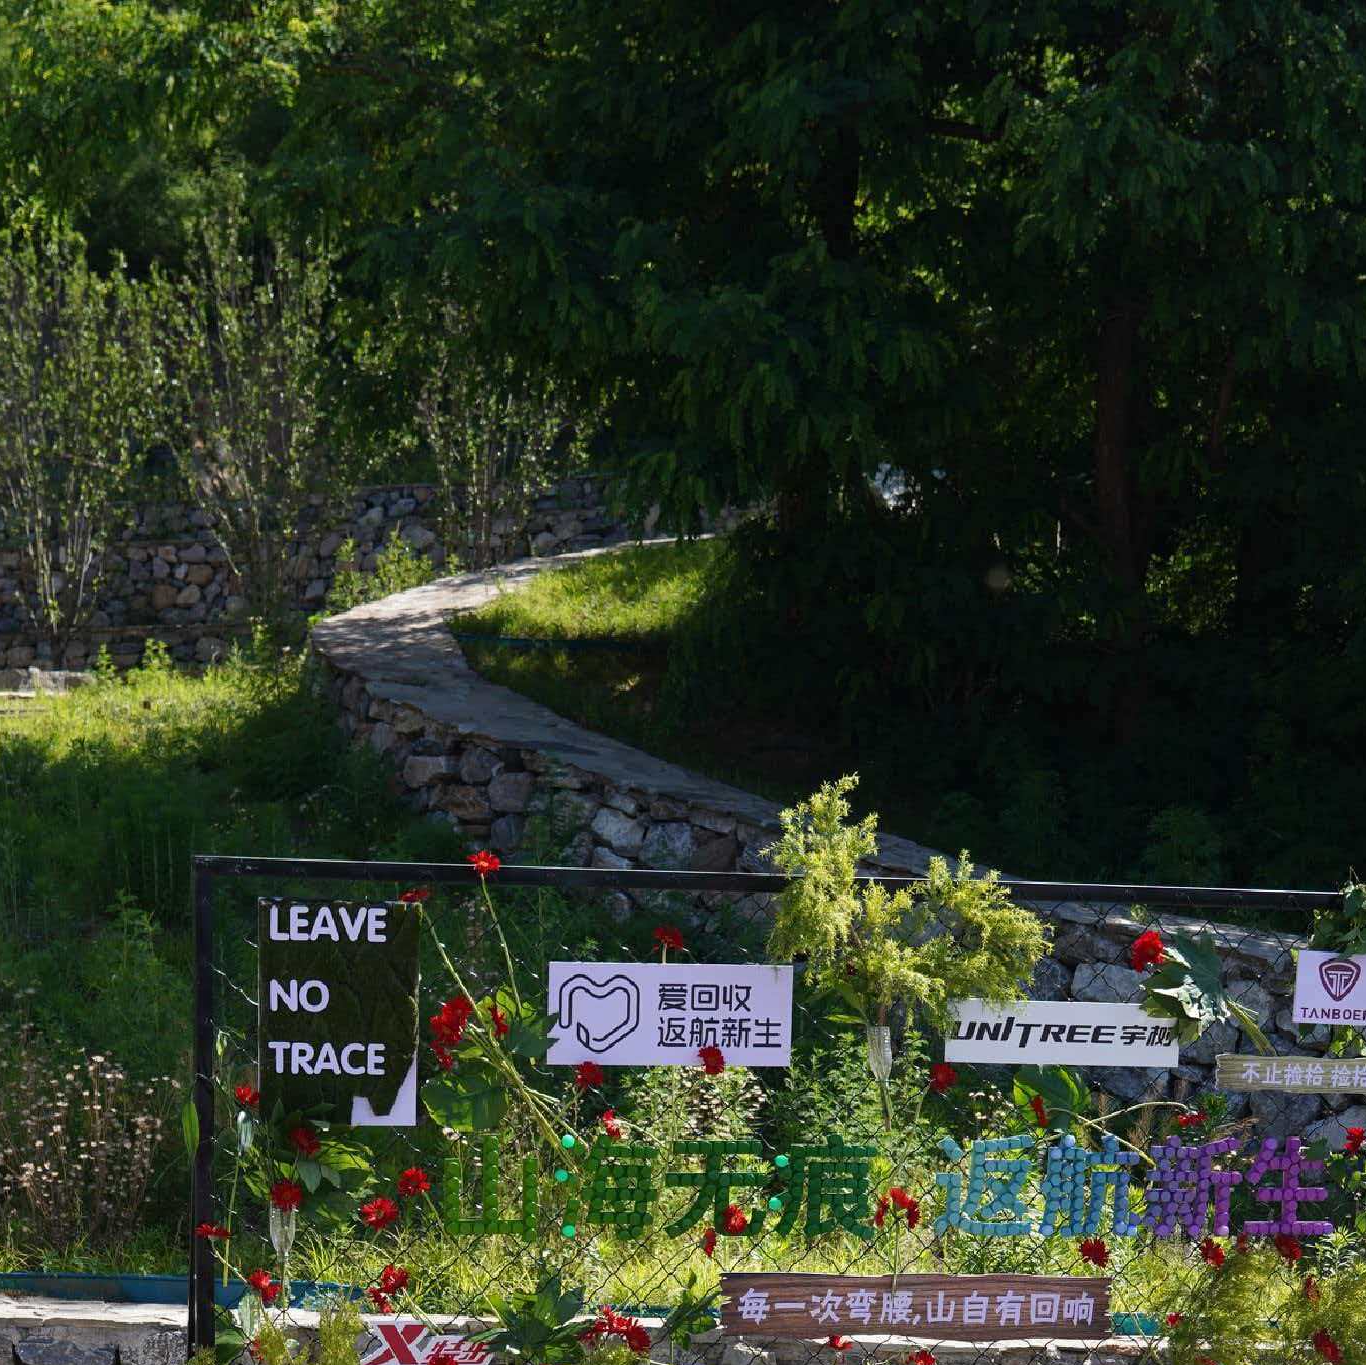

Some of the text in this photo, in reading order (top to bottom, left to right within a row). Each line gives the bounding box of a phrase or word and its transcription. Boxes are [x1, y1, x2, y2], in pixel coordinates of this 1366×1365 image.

[269, 906, 387, 944] LEAVE
[269, 979, 330, 1013] NO
[657, 982, 752, 1012] 爱回收
[656, 1017, 783, 1050] 返航新生
[954, 1016, 1117, 1049] UNITREE
[269, 1040, 386, 1076] TRACE
[934, 1134, 1335, 1238] 返航新生
[737, 1286, 1096, 1328] 每一次弯腰,山自有回响
